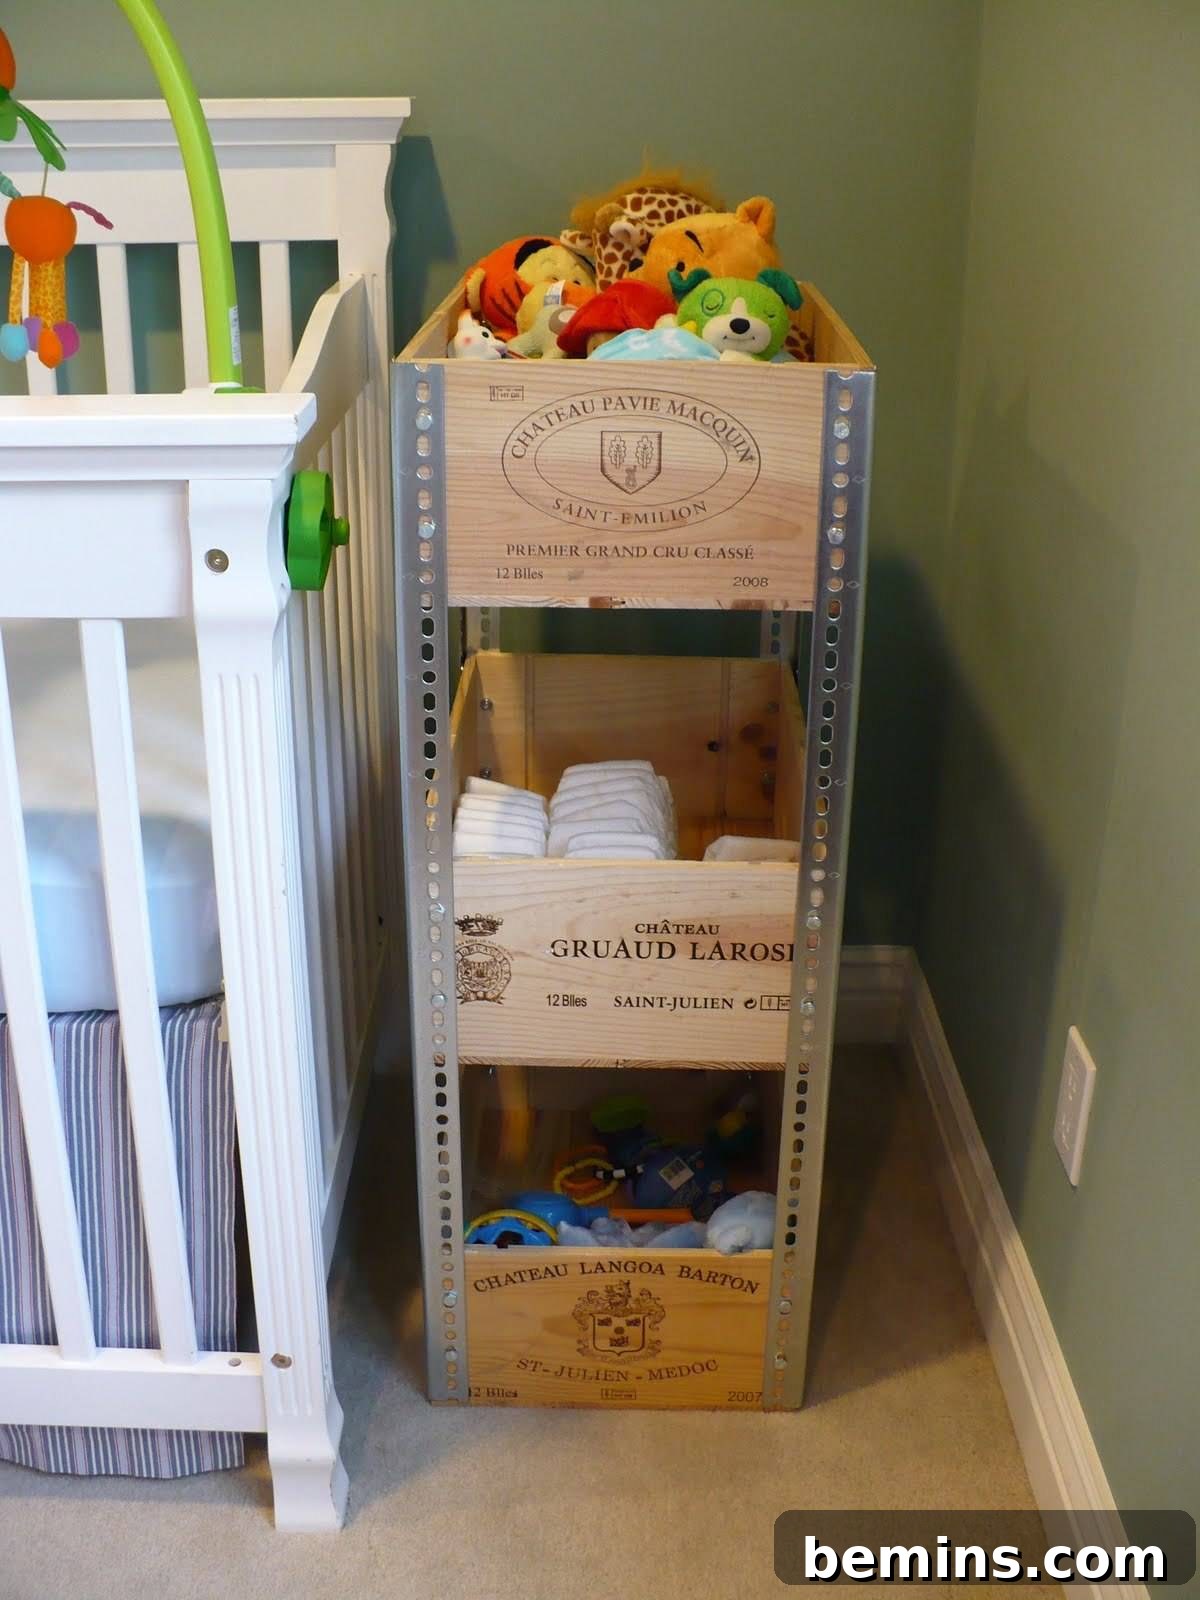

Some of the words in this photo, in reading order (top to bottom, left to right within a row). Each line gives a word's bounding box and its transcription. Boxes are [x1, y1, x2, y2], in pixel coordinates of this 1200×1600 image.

[511, 399, 596, 459] CHATEAU
[602, 396, 661, 411] PAVIE
[667, 399, 755, 464] MACQUIN
[553, 498, 708, 525] SAINT-EMILION
[506, 544, 580, 557] PREMIER
[586, 545, 648, 558] GRAND
[653, 546, 689, 559] CRU
[694, 544, 754, 561] CLASSÉ
[496, 568, 511, 580] 12
[733, 576, 769, 588] 2008
[634, 920, 721, 936] CHÂTEAU
[550, 940, 677, 961] GRUAUD
[546, 994, 560, 1007] 12
[613, 995, 735, 1012] SAINT-JULIEN
[473, 1264, 569, 1293] CHATEAU
[579, 1260, 665, 1276] LANGOA
[677, 1265, 761, 1295] BARTON
[647, 1359, 719, 1381] MEDOC
[727, 1391, 763, 1402] 2007
